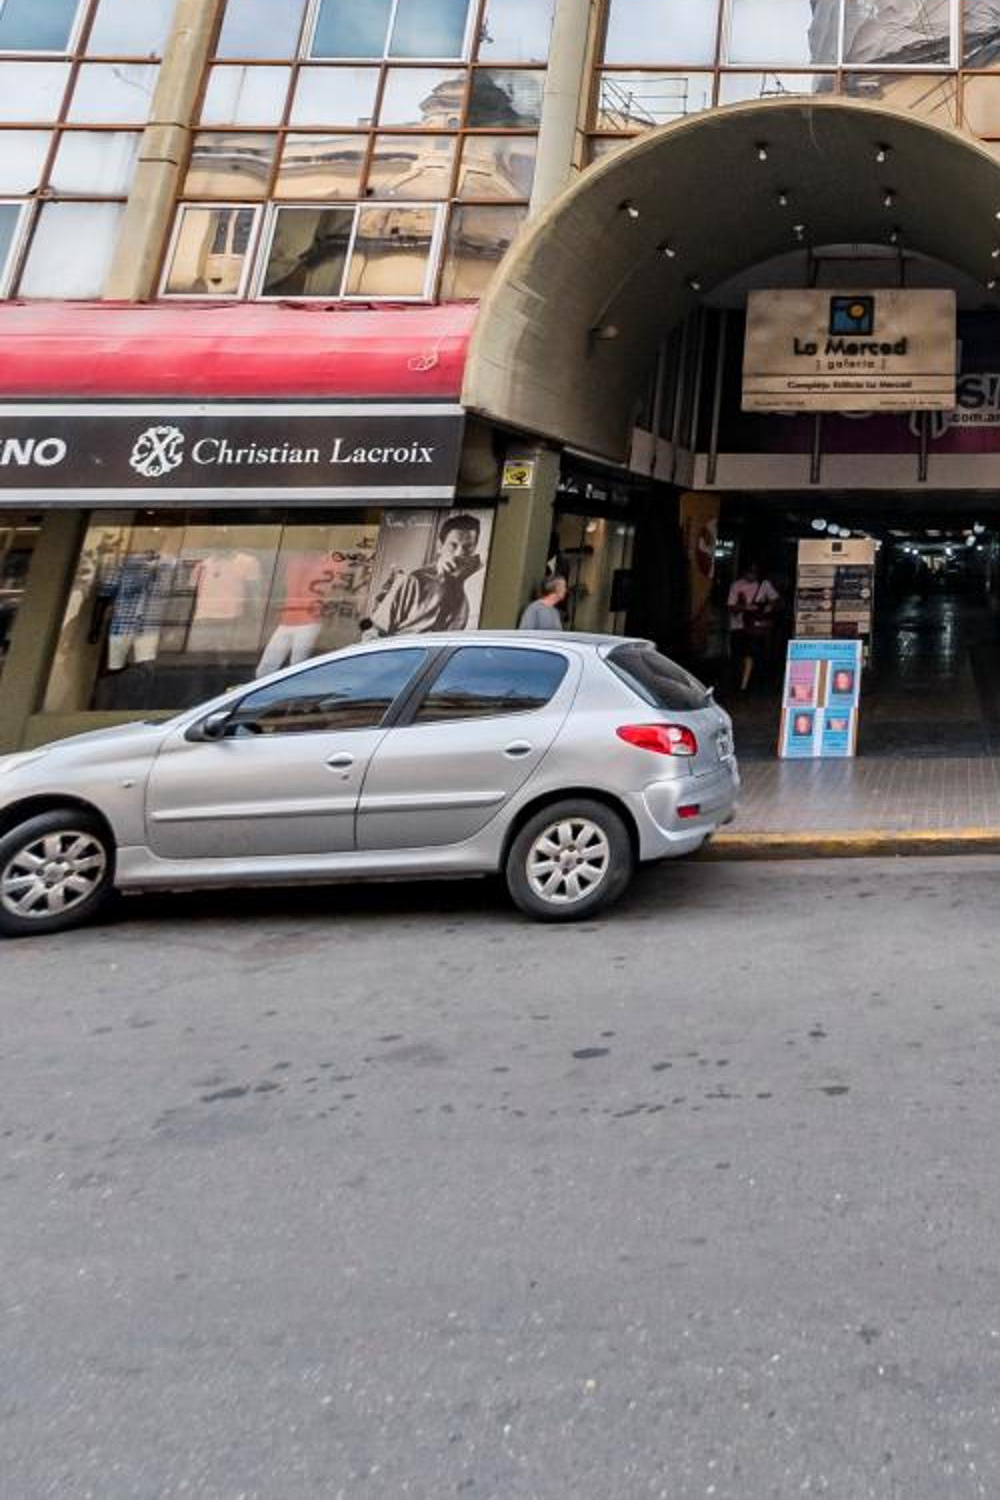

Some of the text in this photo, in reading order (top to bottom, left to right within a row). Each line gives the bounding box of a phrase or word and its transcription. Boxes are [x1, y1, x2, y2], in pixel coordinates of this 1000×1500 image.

[793, 336, 908, 356] La Merced
[0, 437, 67, 467] NO
[191, 438, 320, 465] Christian
[330, 438, 434, 464] Lacroix
